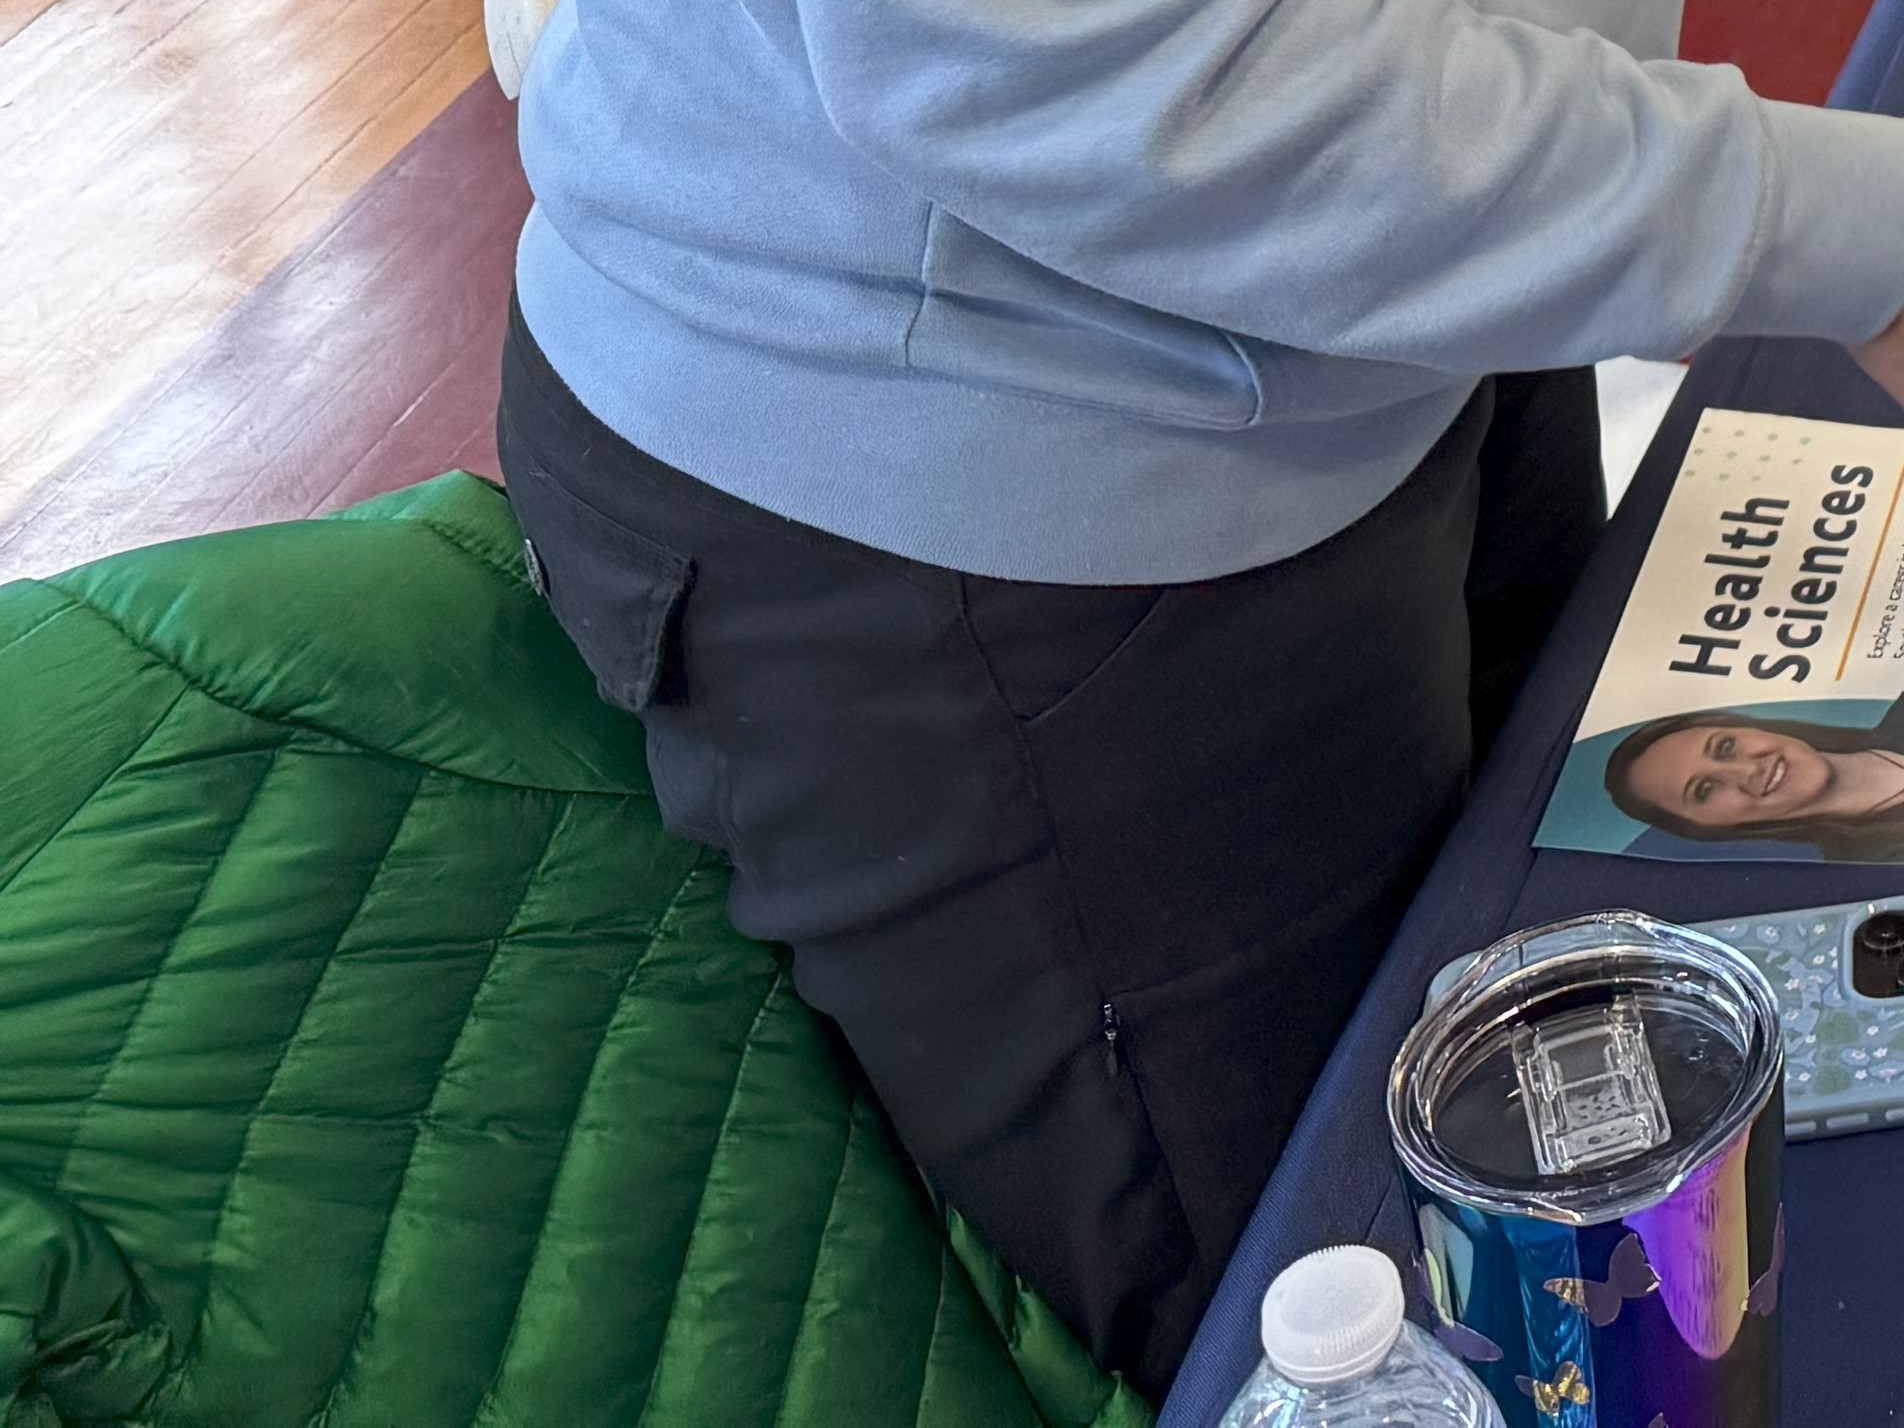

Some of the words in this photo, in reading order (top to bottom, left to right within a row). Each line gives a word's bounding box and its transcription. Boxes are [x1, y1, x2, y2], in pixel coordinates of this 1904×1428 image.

[1670, 498, 1787, 675] Health
[1749, 465, 1872, 680] Sciences
[1866, 614, 1895, 659] Explore
[1884, 603, 1898, 612] a
